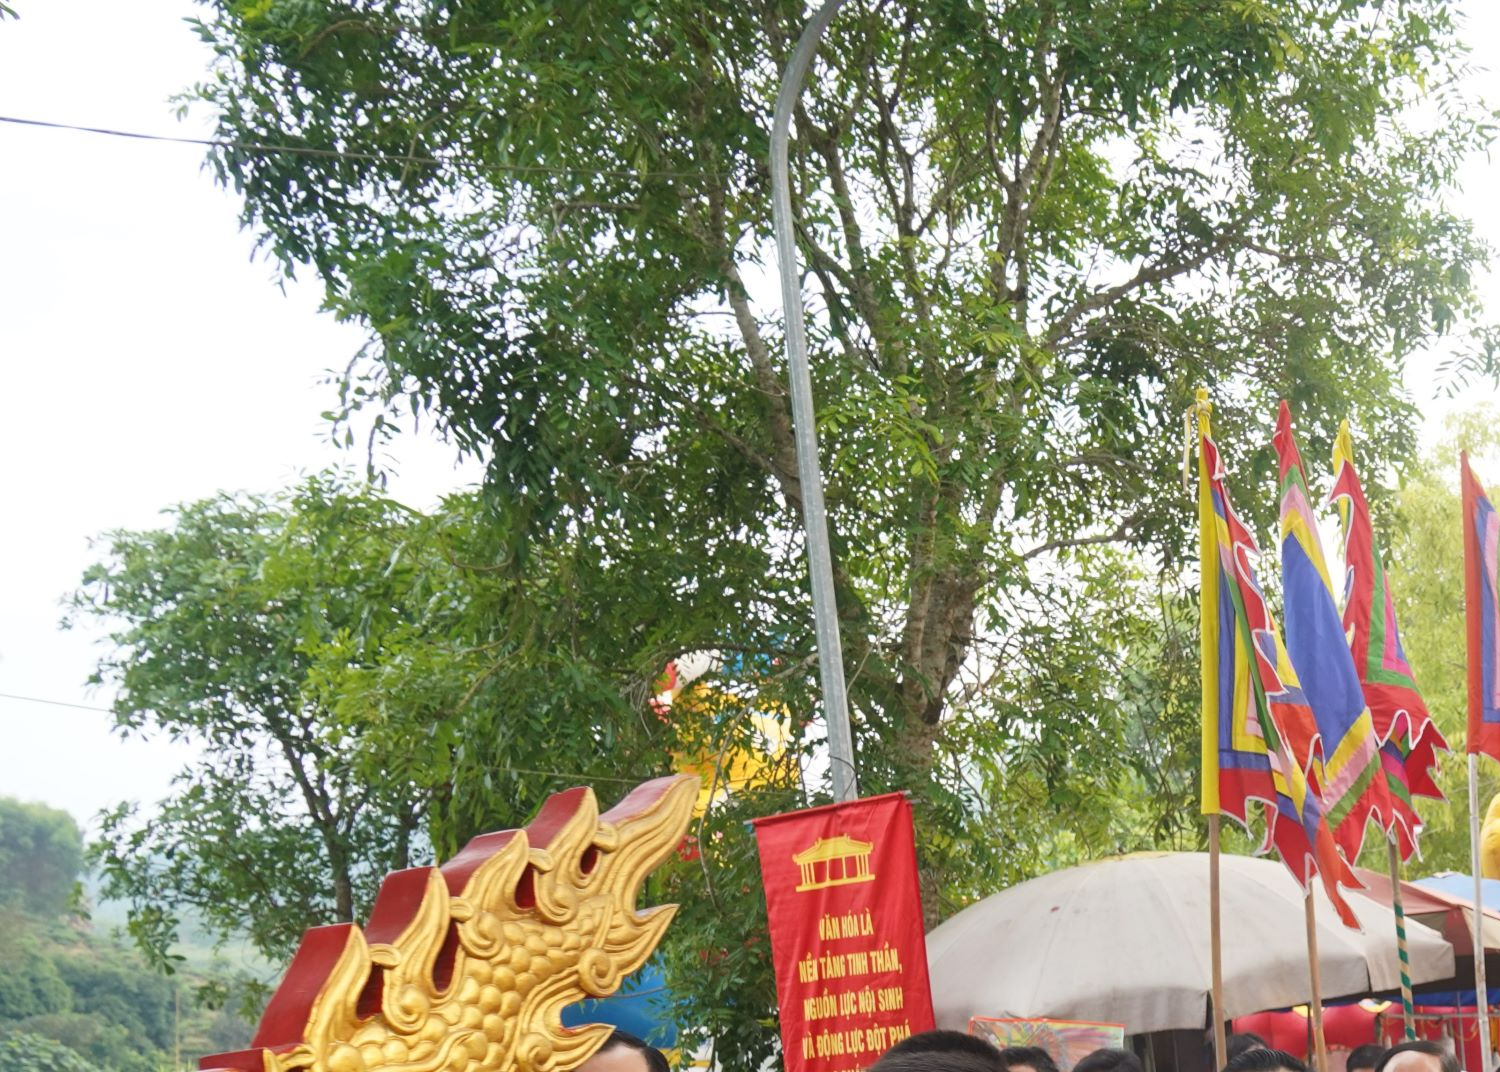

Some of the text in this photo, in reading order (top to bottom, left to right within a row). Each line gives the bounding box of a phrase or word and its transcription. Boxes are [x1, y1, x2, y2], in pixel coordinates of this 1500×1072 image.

[819, 907, 874, 940] VĂN HÓA LÀ
[819, 950, 846, 979] TẢNG
[846, 951, 869, 976] TINH
[840, 989, 857, 1020] LỰC
[858, 985, 876, 1018] NỘI
[877, 986, 904, 1012] SINH
[802, 1031, 815, 1060] VÀ
[816, 1028, 844, 1061] ĐỘNG
[845, 1027, 865, 1058] LỰC
[866, 1022, 887, 1056] ĐỘT
